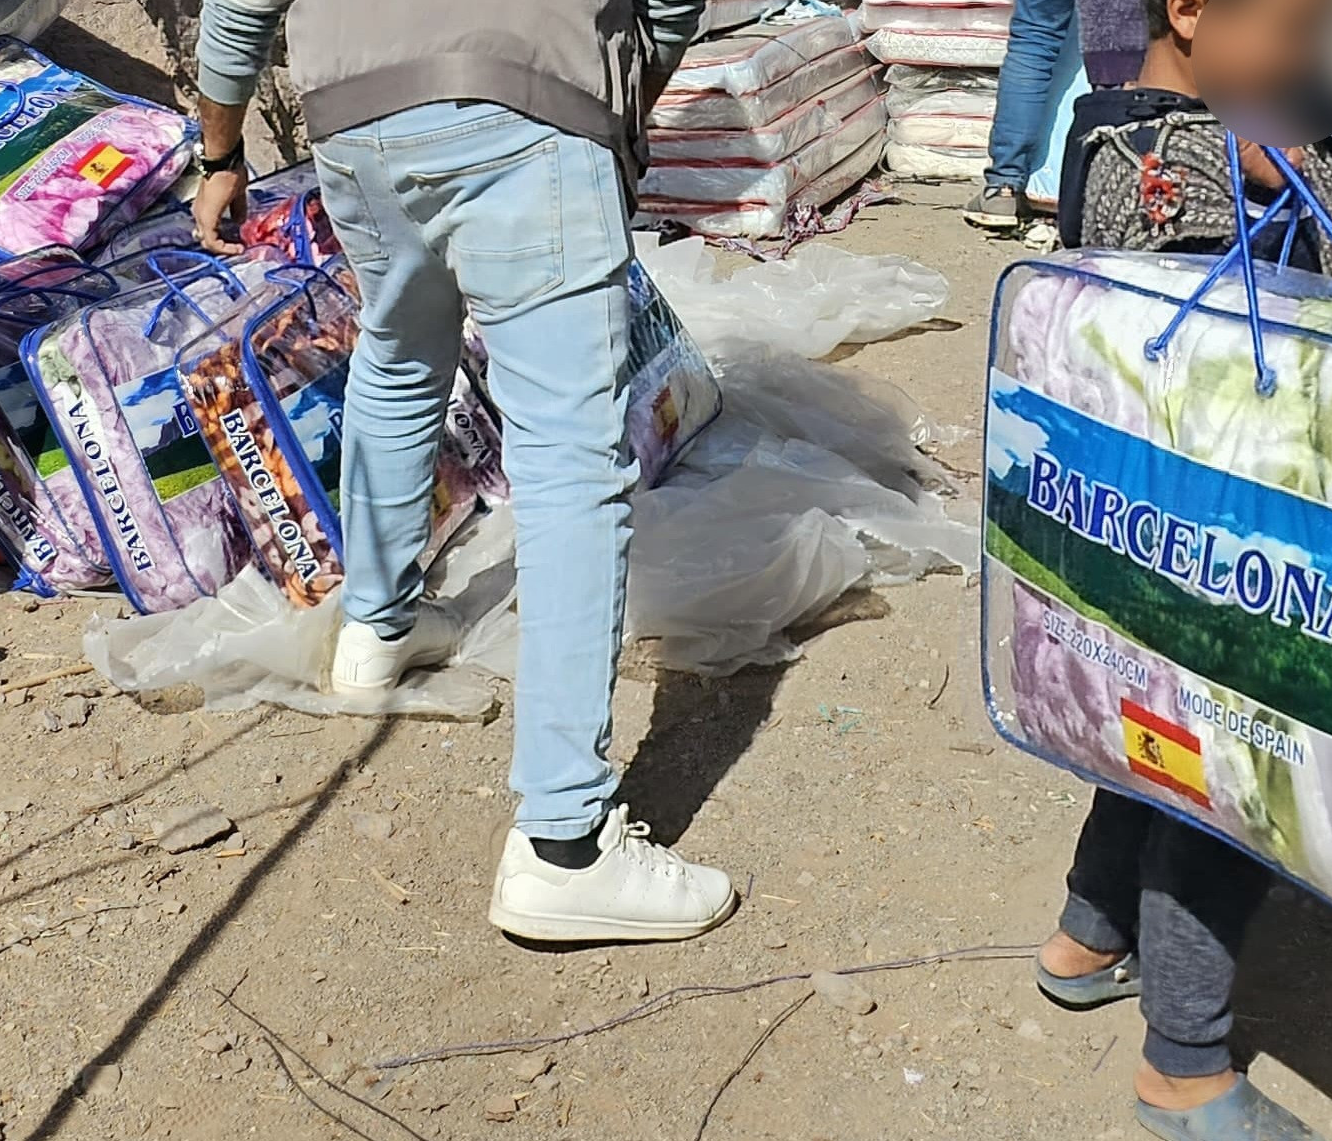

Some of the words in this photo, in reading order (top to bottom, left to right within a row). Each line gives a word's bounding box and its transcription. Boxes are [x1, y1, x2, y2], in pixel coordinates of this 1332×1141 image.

[69, 401, 154, 572] BARCELONA
[220, 408, 320, 582] BARCELONA
[1178, 684, 1224, 726] MODE
